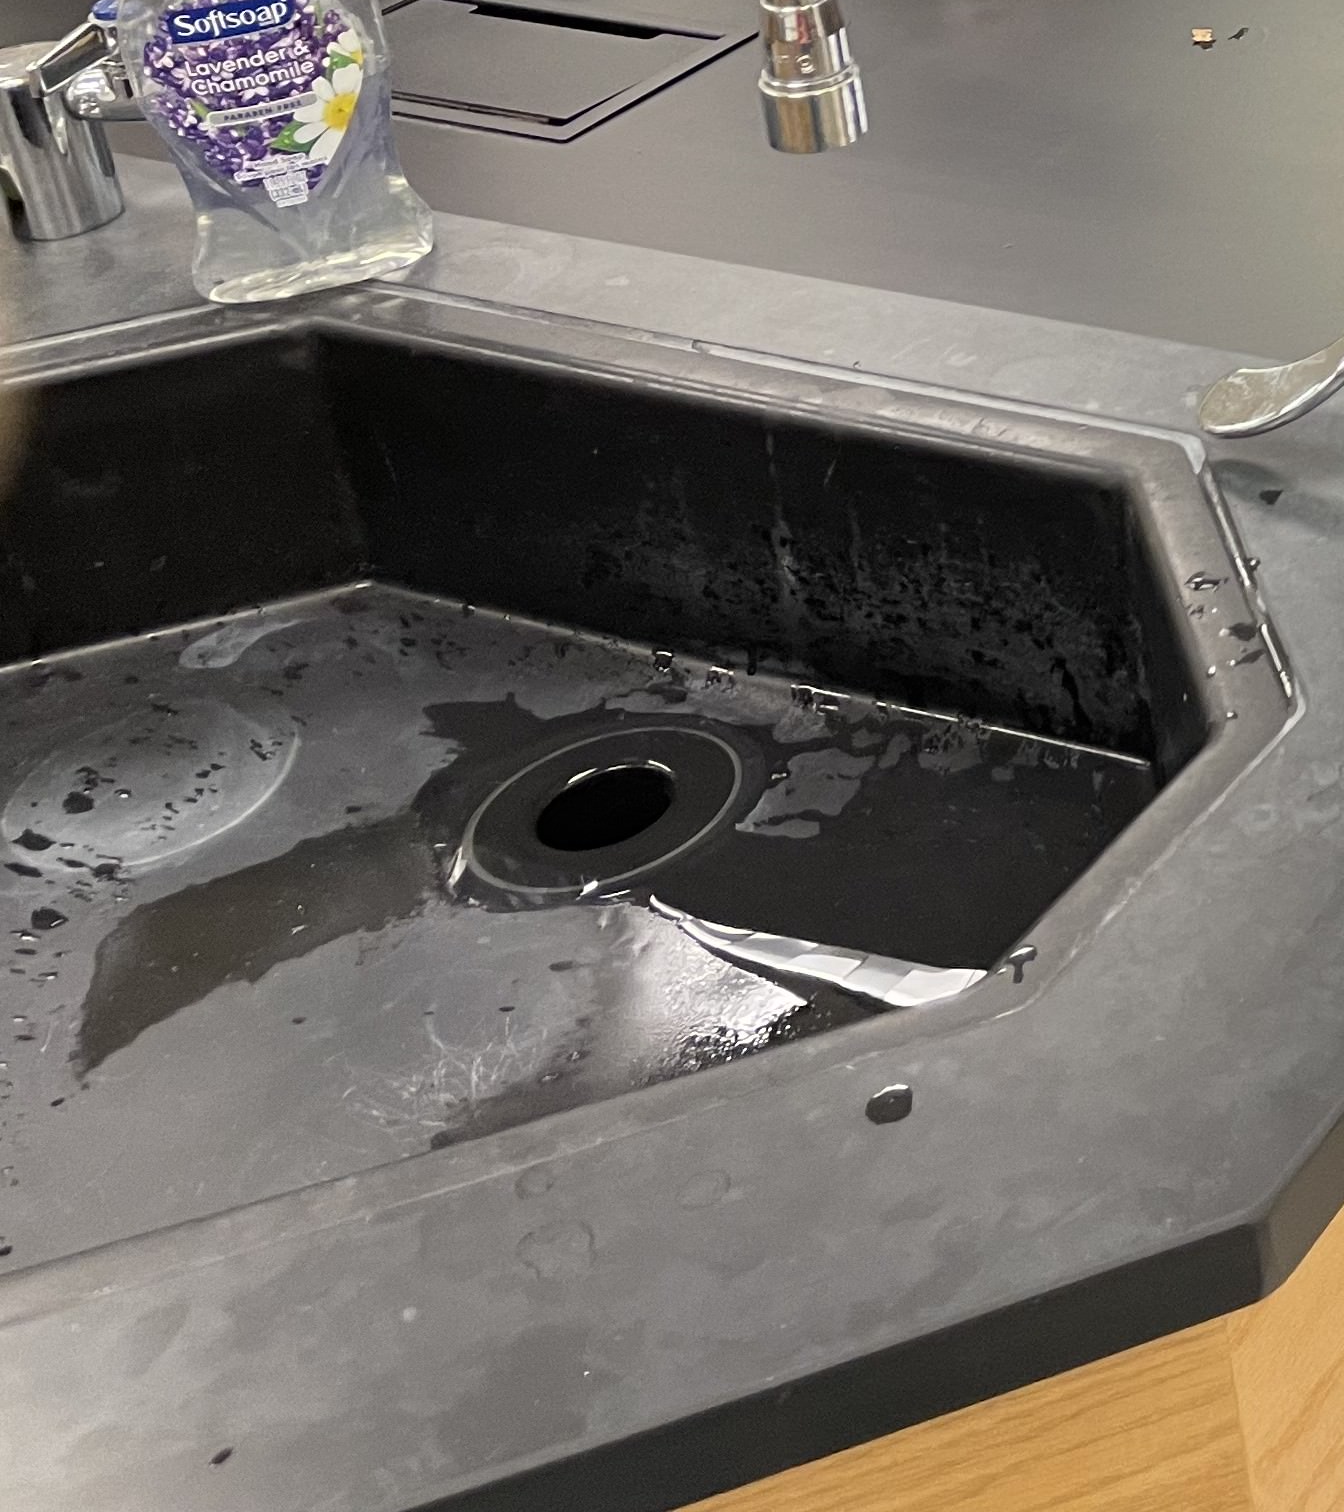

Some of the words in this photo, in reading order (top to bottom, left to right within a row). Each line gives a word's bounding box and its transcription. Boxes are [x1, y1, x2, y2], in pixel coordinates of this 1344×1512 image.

[173, 0, 287, 38] Softsoap
[184, 47, 294, 78] Lavender
[293, 40, 311, 57] &
[191, 59, 315, 96] Chamomile
[223, 105, 272, 122] PARABEN
[277, 99, 303, 112] FREE
